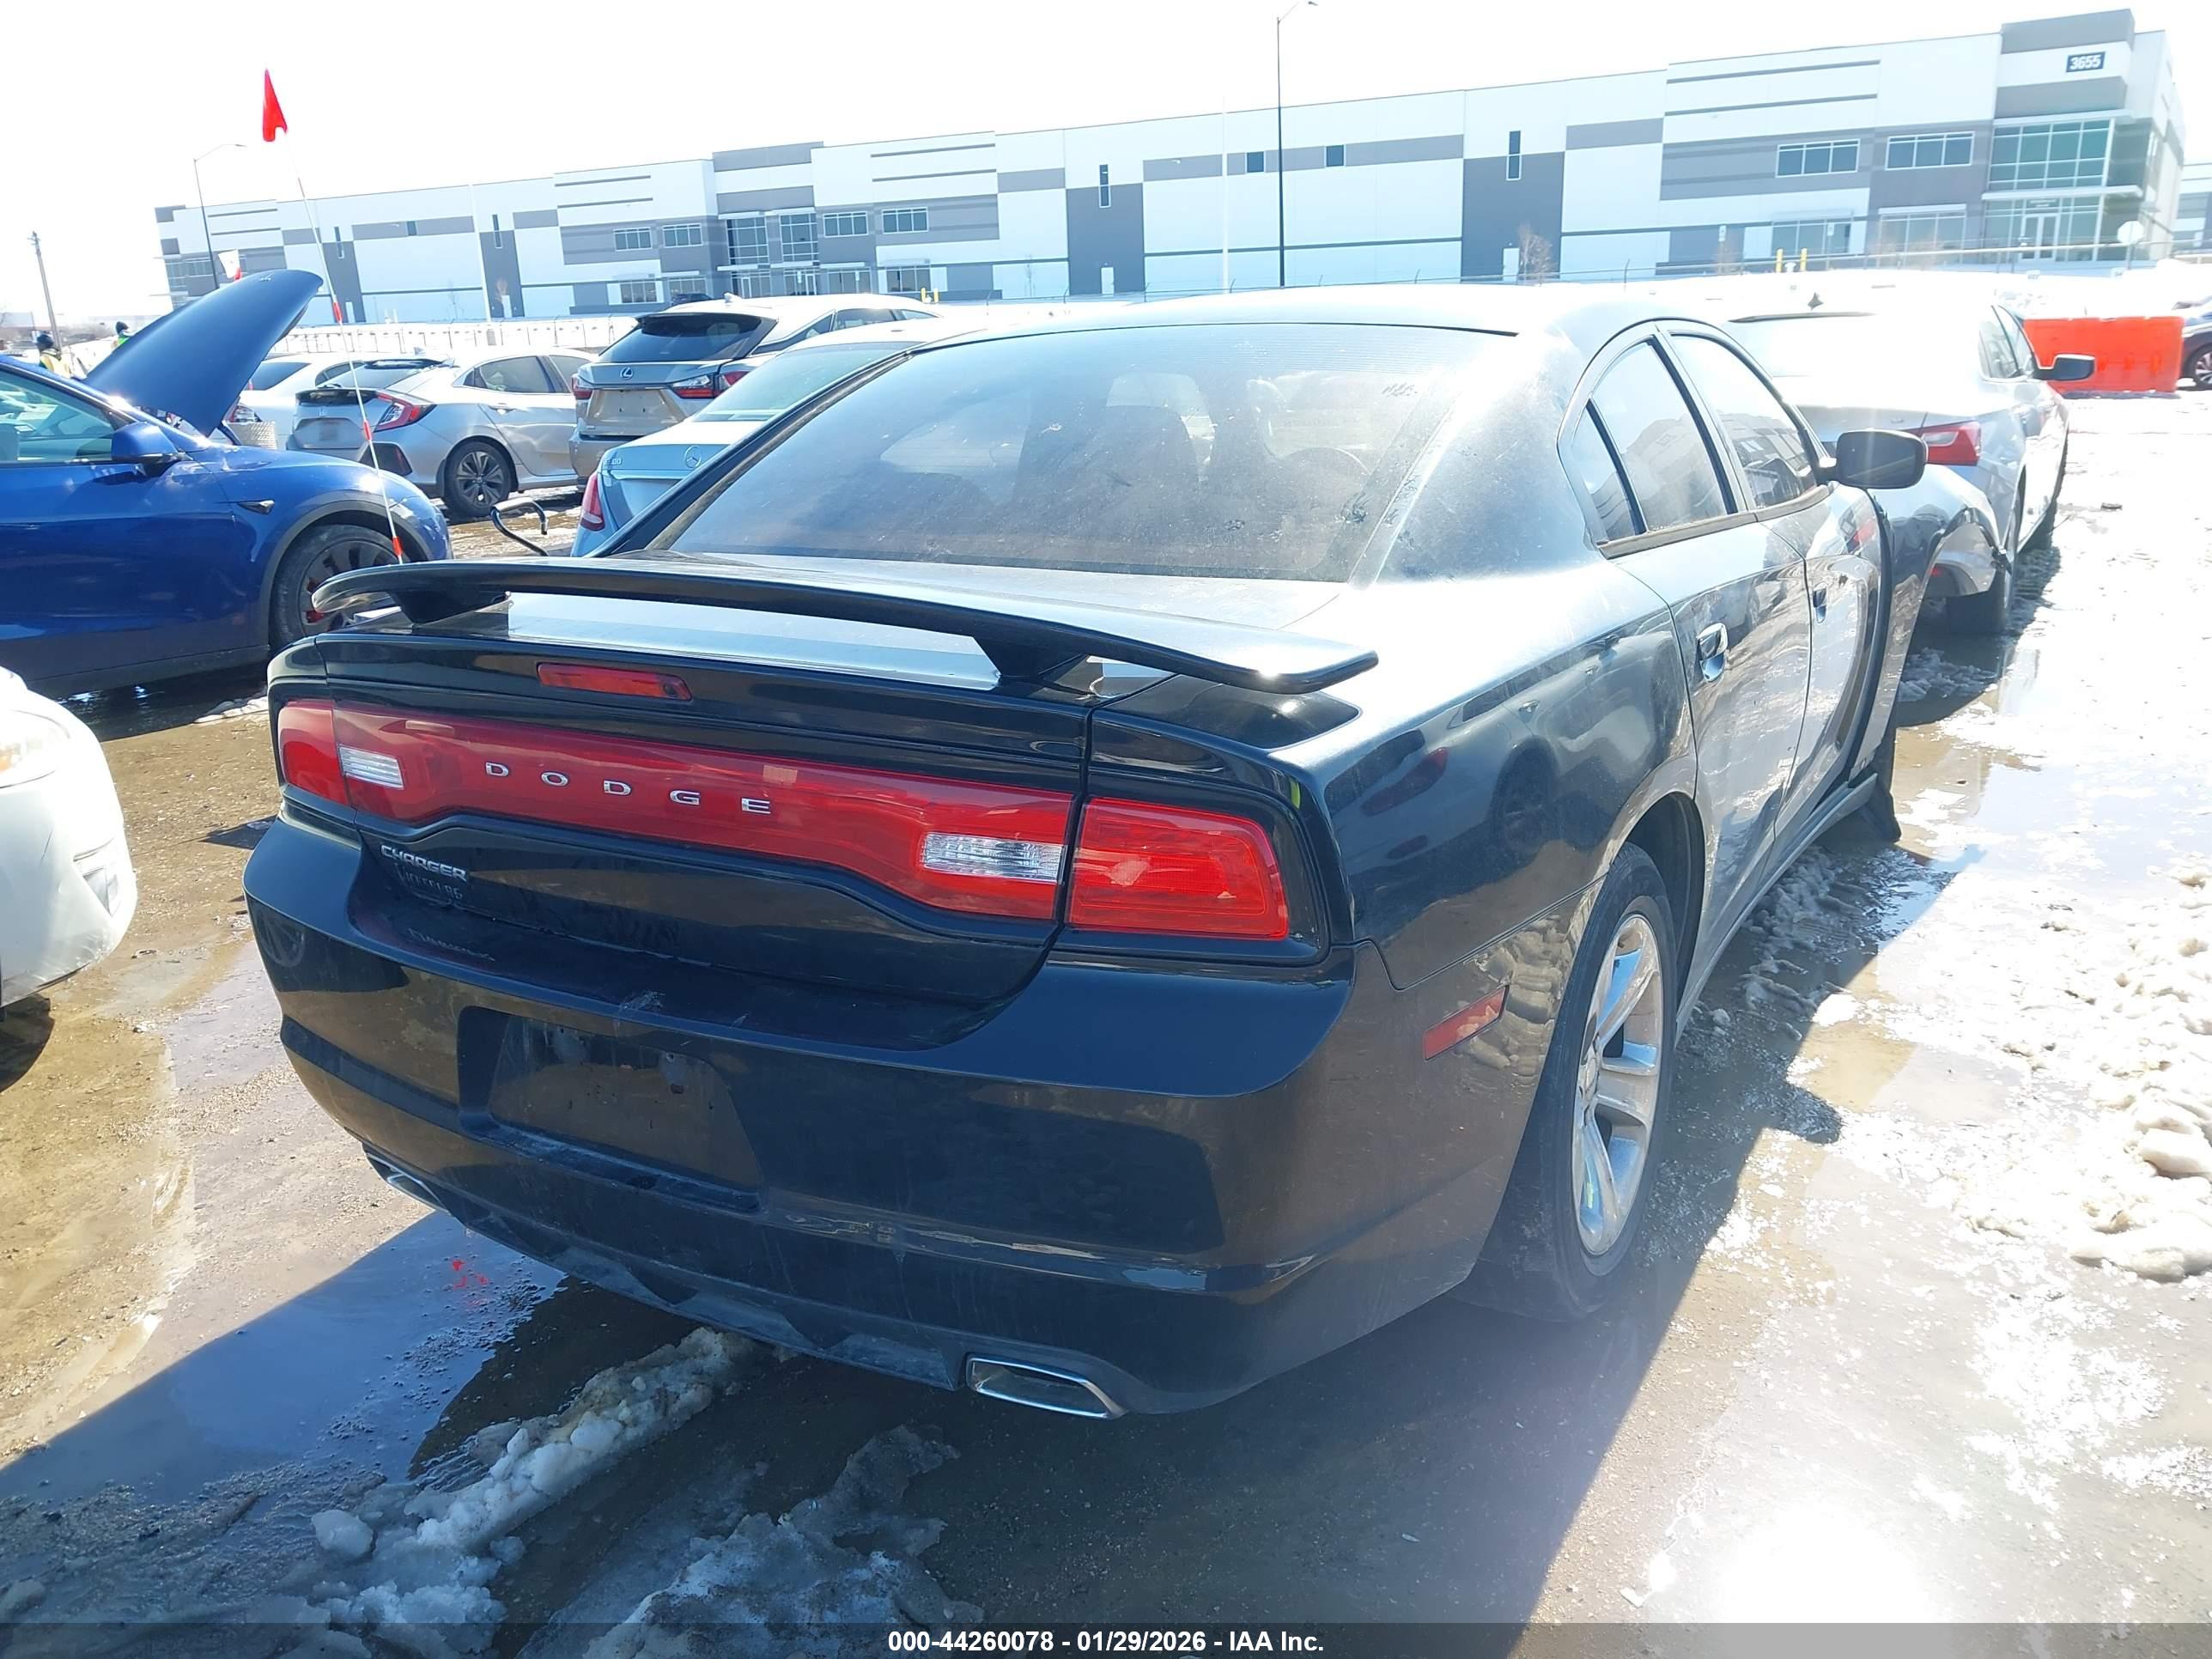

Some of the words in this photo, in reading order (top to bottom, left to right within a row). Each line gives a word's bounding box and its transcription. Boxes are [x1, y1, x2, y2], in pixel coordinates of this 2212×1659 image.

[2069, 54, 2102, 70] 3655
[484, 761, 771, 815] DODGE
[380, 844, 468, 883] CHARGER
